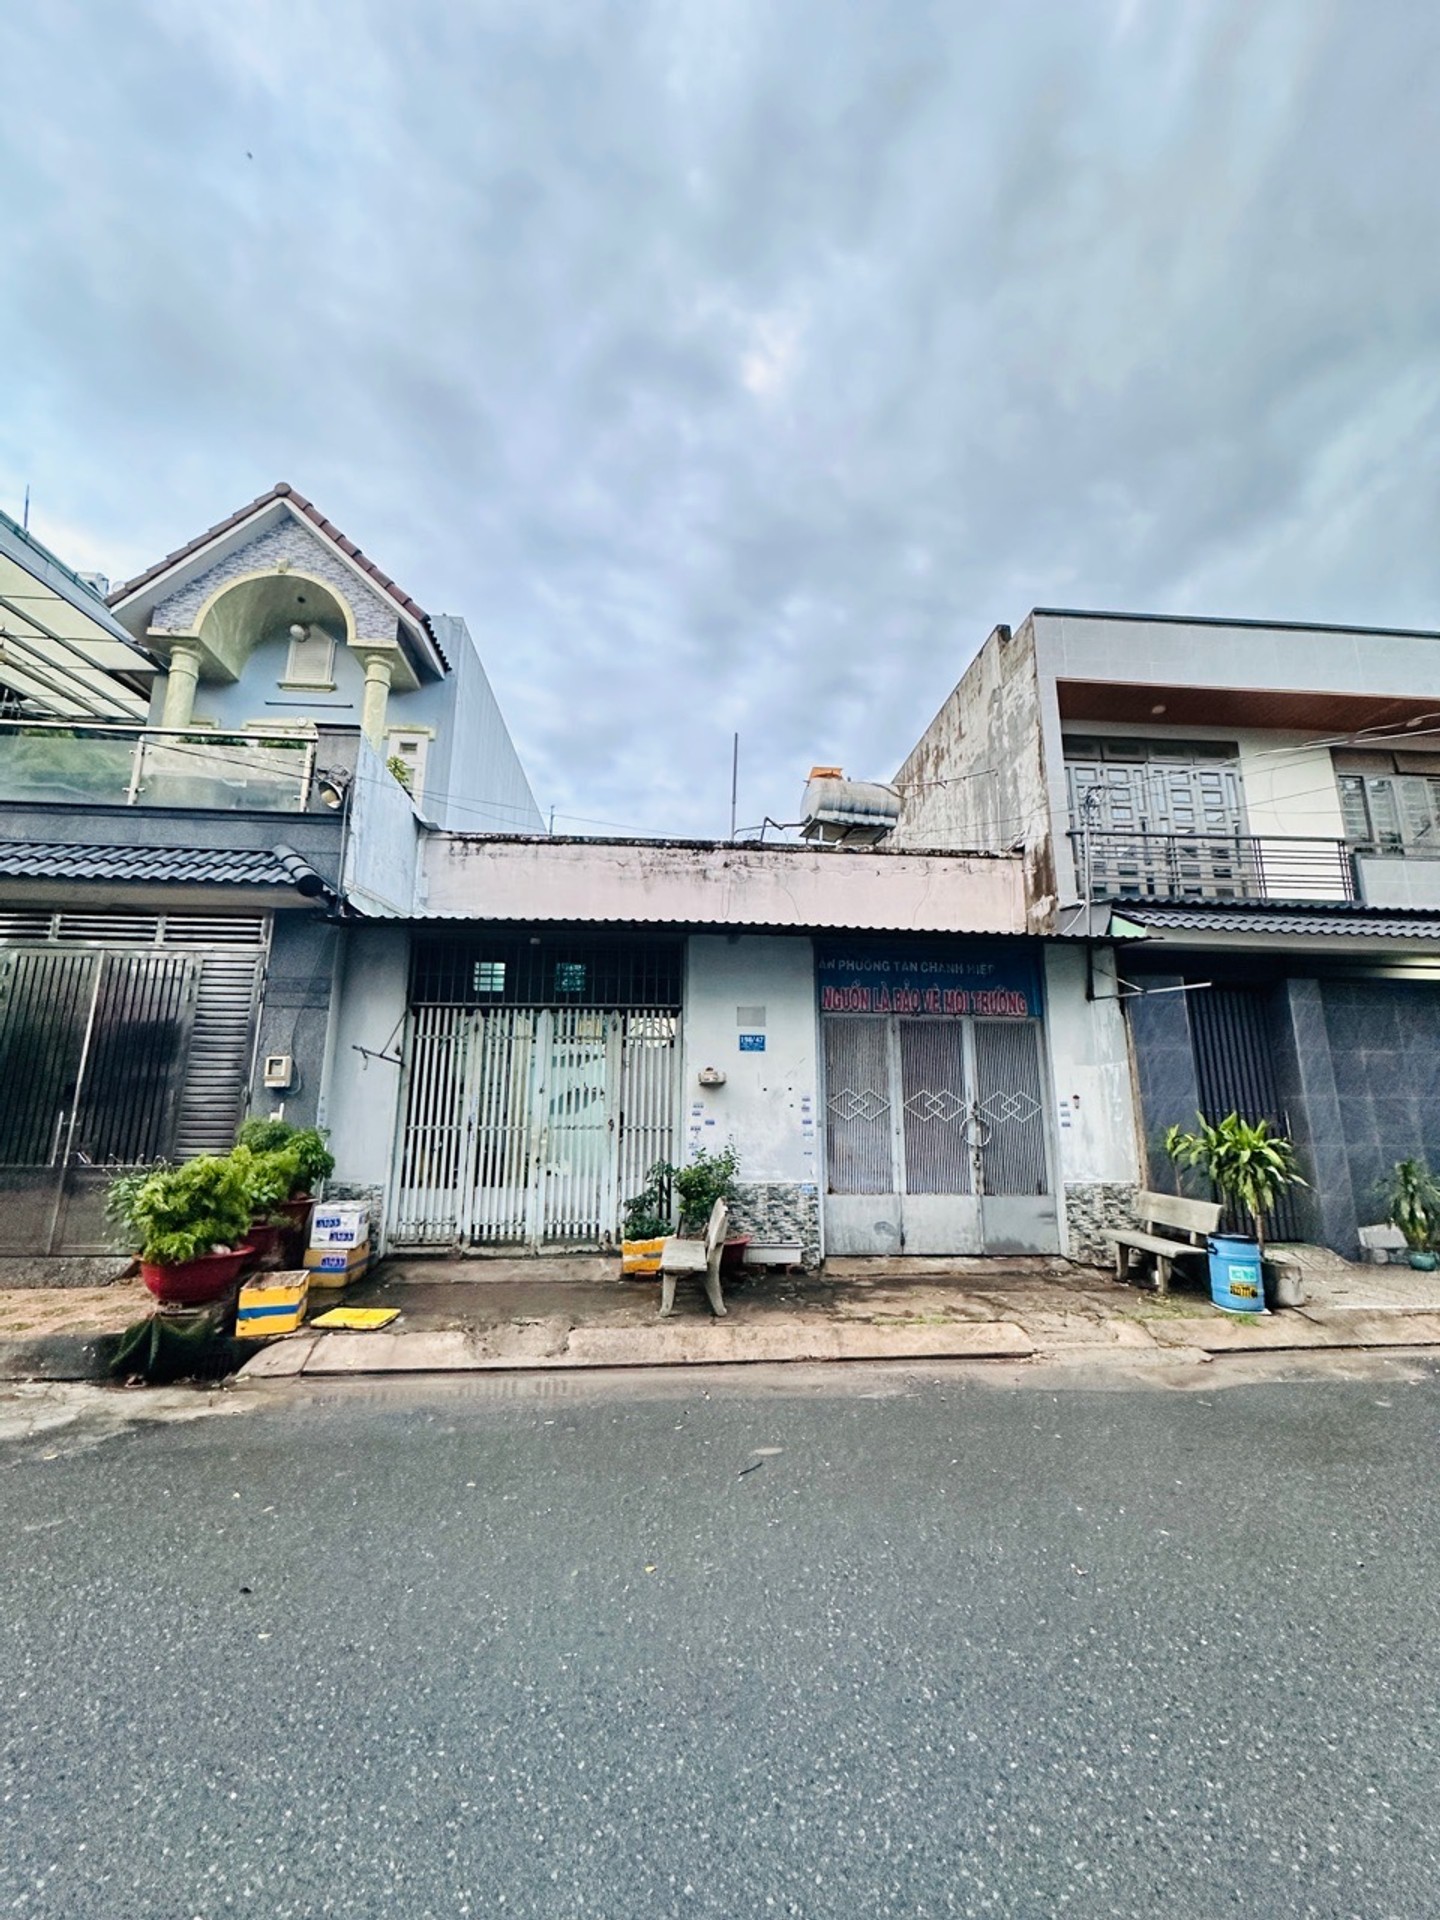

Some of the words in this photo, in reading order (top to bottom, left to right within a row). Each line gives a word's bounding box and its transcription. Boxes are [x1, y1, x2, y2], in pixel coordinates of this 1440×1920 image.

[872, 980, 892, 1013] LÀ
[892, 977, 921, 1013] BẢO
[943, 984, 971, 1014] MÔI
